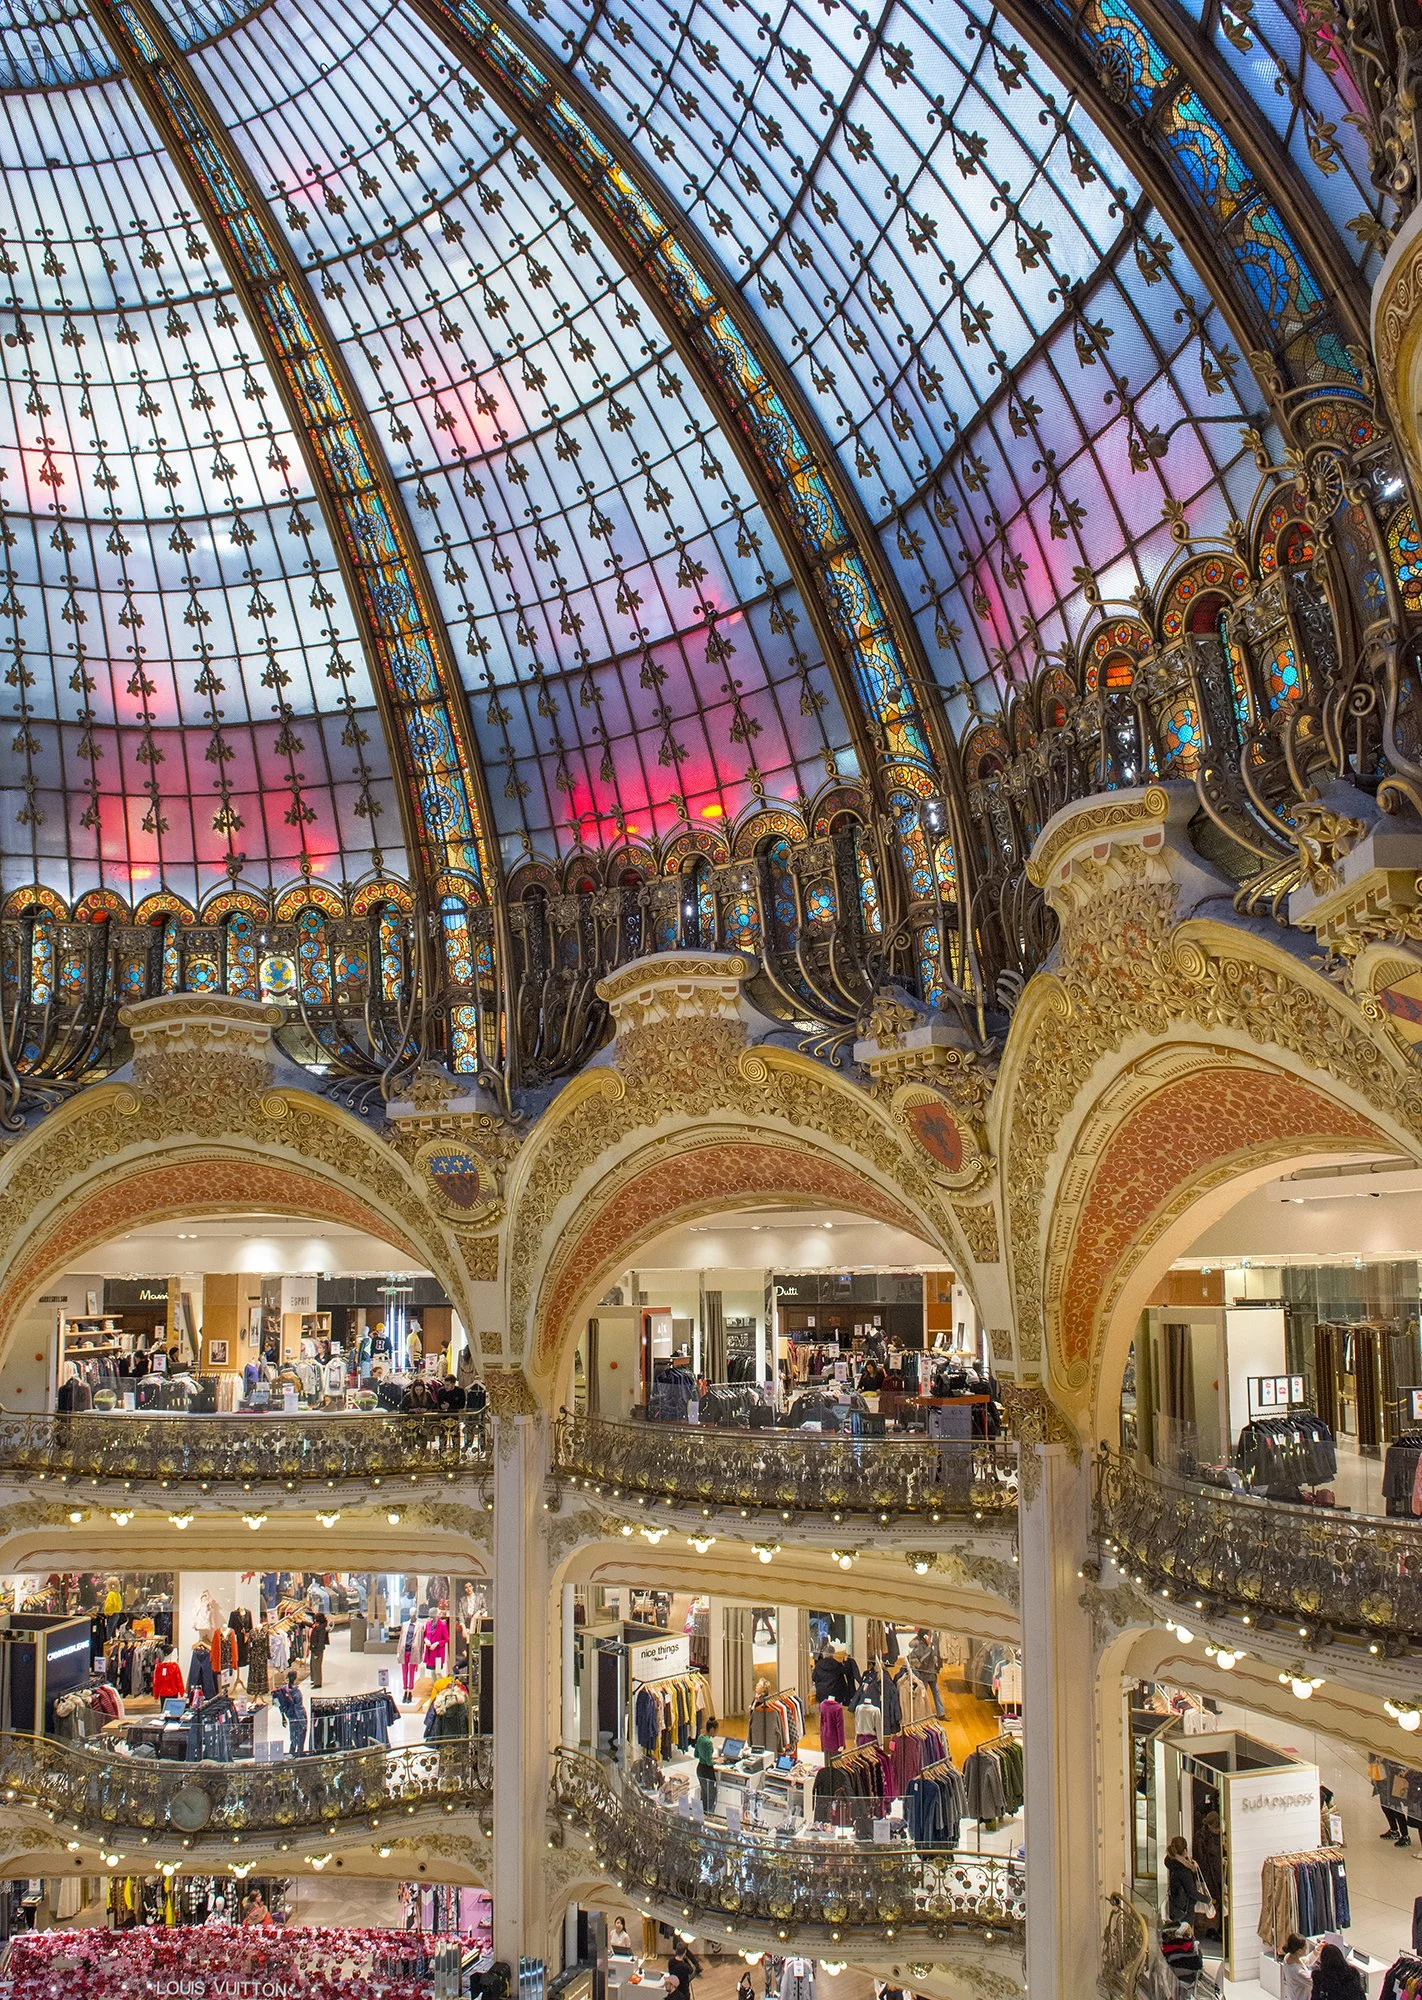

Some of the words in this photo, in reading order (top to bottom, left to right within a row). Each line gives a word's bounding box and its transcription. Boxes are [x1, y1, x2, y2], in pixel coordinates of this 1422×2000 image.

[775, 1285, 798, 1296] Dutti
[290, 1296, 310, 1307] ESPRIT
[640, 1649, 656, 1659] nice
[657, 1644, 680, 1655] things
[156, 1981, 206, 1995] LOUIS
[214, 1980, 287, 1997] VUITTON
